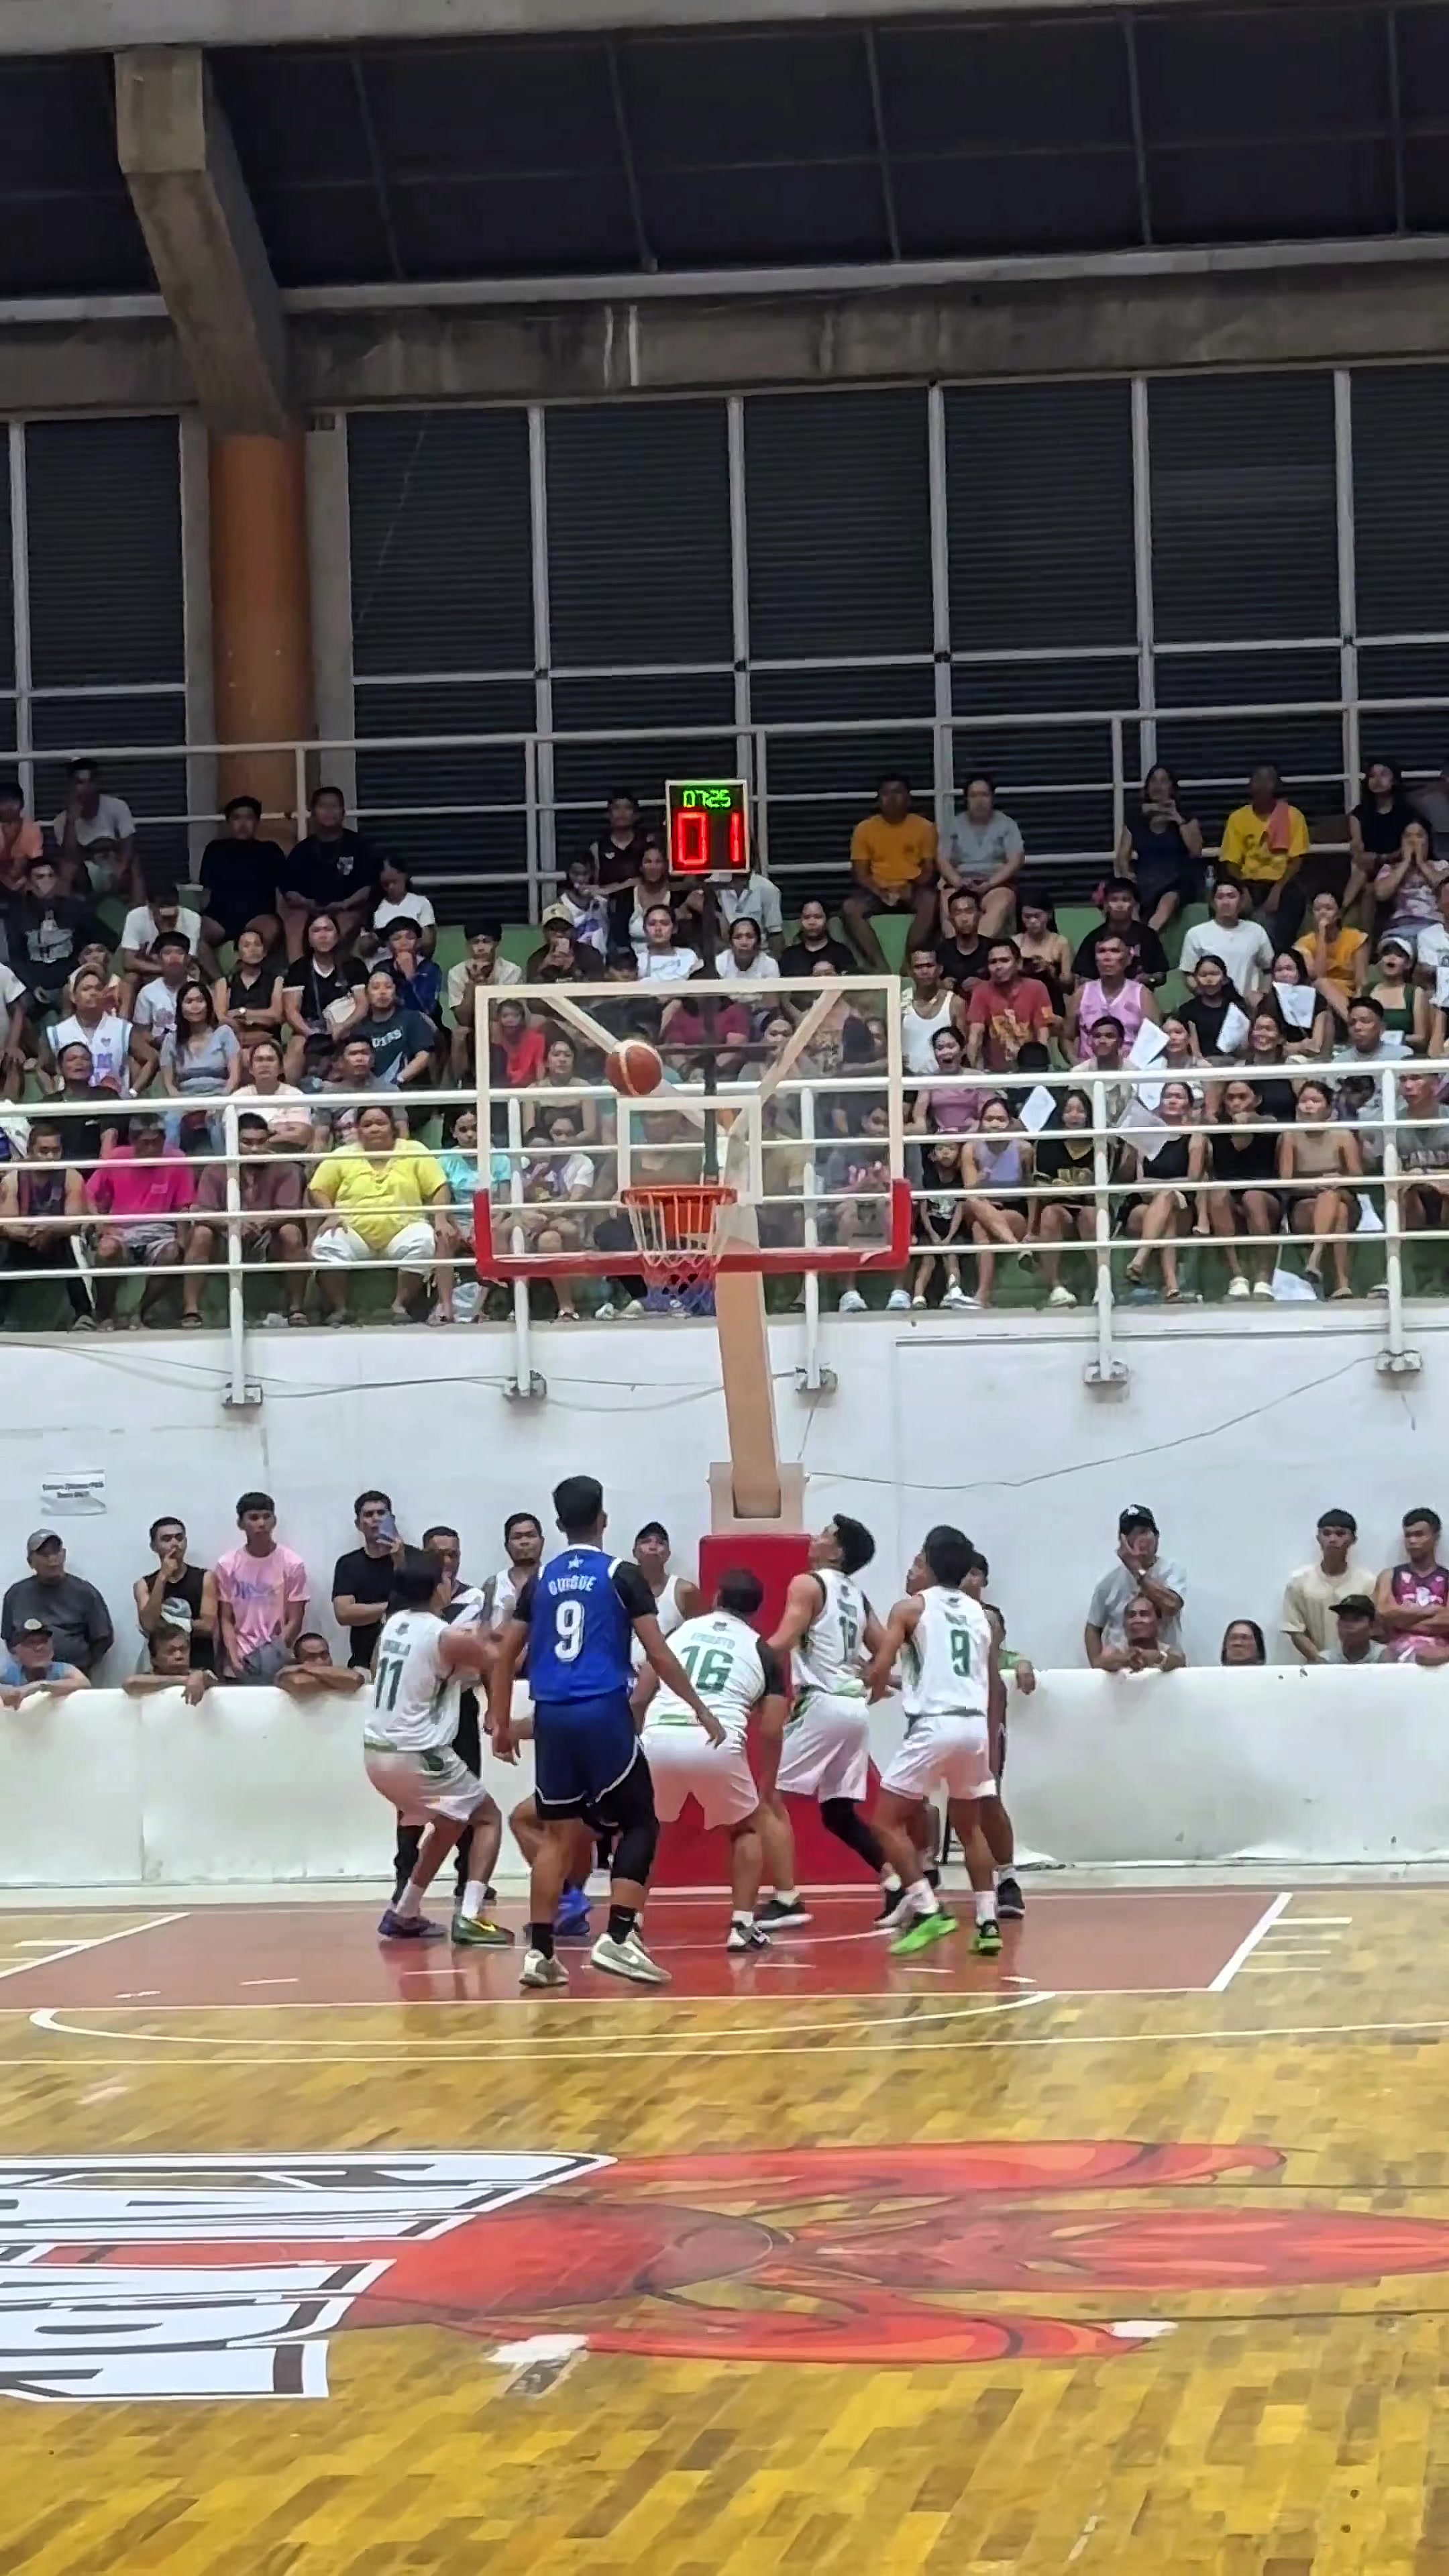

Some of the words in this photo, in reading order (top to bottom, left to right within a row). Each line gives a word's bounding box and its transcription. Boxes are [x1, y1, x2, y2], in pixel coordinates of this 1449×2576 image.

[678, 812, 739, 865] 01
[555, 1600, 585, 1662] 9
[951, 1629, 971, 1676] 9
[375, 1657, 404, 1712] 11
[682, 1645, 735, 1695] 16
